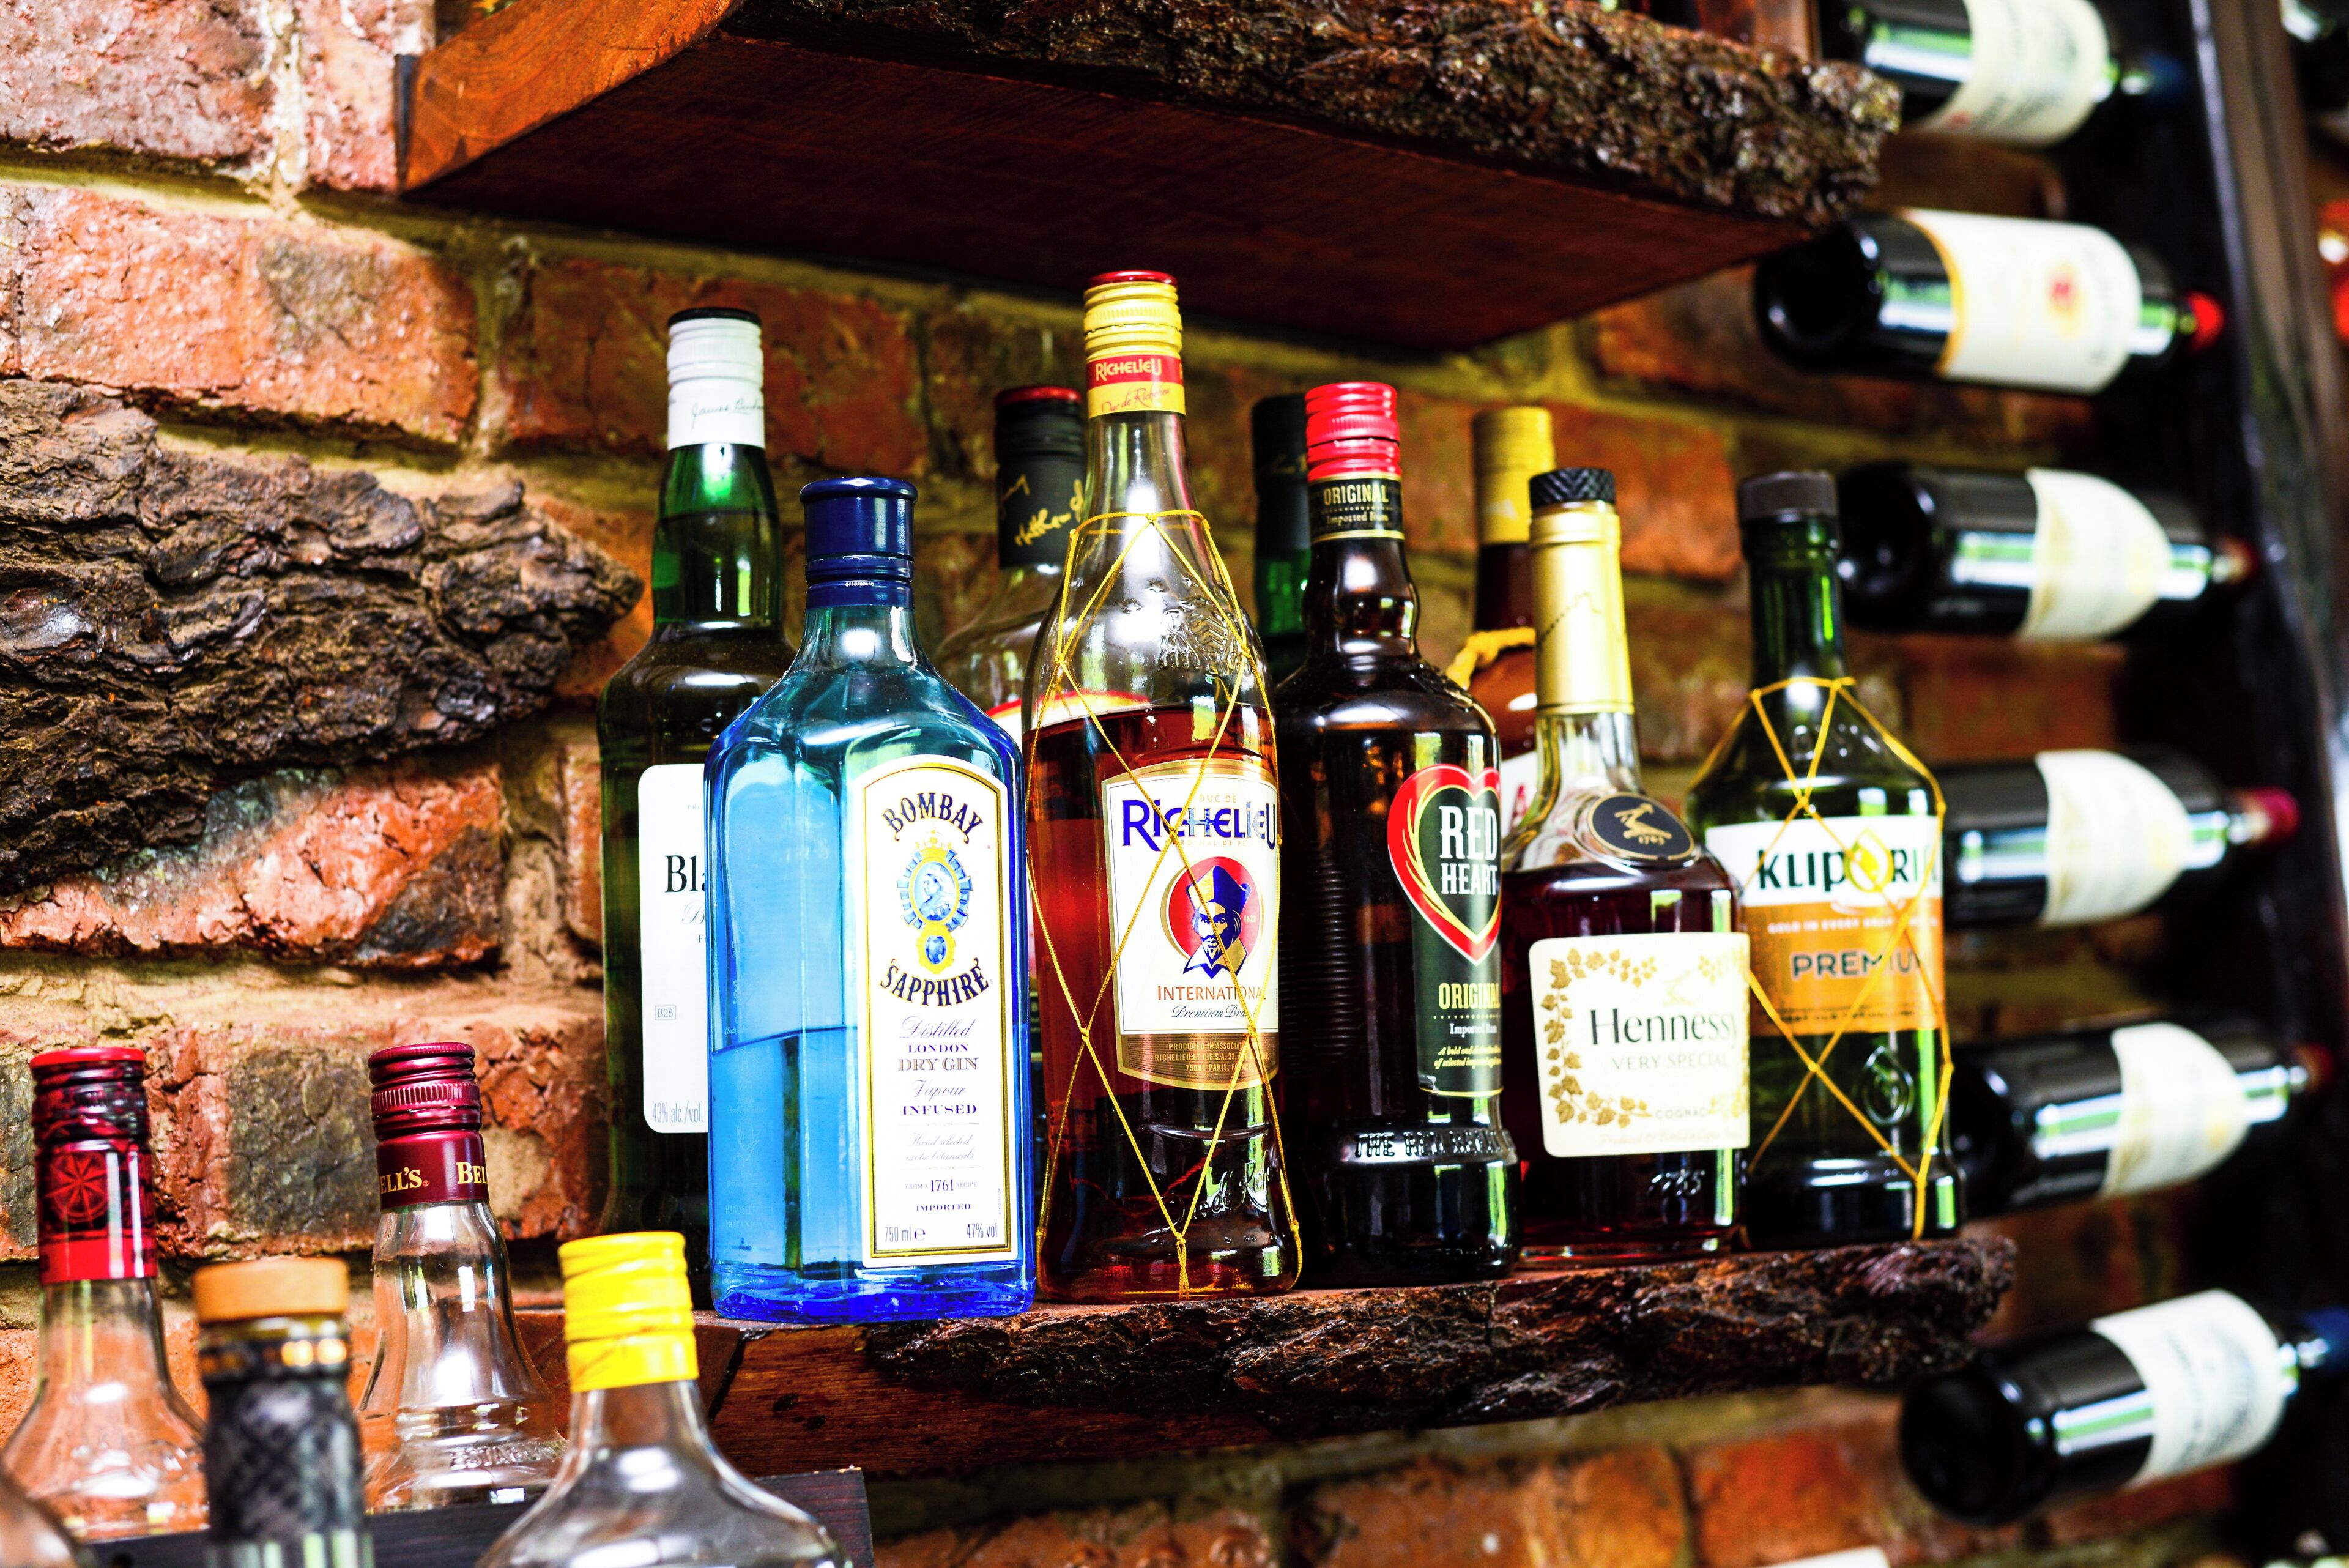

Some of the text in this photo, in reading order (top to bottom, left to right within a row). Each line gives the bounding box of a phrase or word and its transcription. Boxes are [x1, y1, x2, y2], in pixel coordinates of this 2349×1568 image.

[1323, 484, 1389, 505] ORIGINAL
[1199, 794, 1236, 803] DUC DE
[882, 792, 984, 844] BOMBAY
[1439, 806, 1498, 861] RED
[664, 855, 705, 893] Bl
[1441, 863, 1498, 895] HEART
[1792, 949, 1924, 979] PREMIU
[879, 957, 990, 1008] SAPPHIRE
[1439, 983, 1501, 1009] ORIGINAL
[658, 1008, 673, 1017] B28
[1171, 1005, 1224, 1018] Premium
[899, 1016, 976, 1038] Distilled
[908, 1044, 968, 1053] LONDON
[897, 1058, 978, 1071] DRY GIN
[1612, 1052, 1727, 1070] VERY SPECIAL
[912, 1079, 967, 1101] Vapour
[652, 1103, 668, 1122] 43%
[903, 1104, 977, 1115] INFUSED
[1655, 1107, 1706, 1119] COGNAC
[910, 1132, 973, 1146] Hand selected
[1355, 1132, 1395, 1158] THE
[932, 1146, 976, 1160] botanicals
[930, 1179, 954, 1192] 1761
[884, 1227, 899, 1242] 750
[902, 1226, 911, 1241] ml
[966, 1223, 984, 1238] 47%
[986, 1222, 998, 1238] vol
